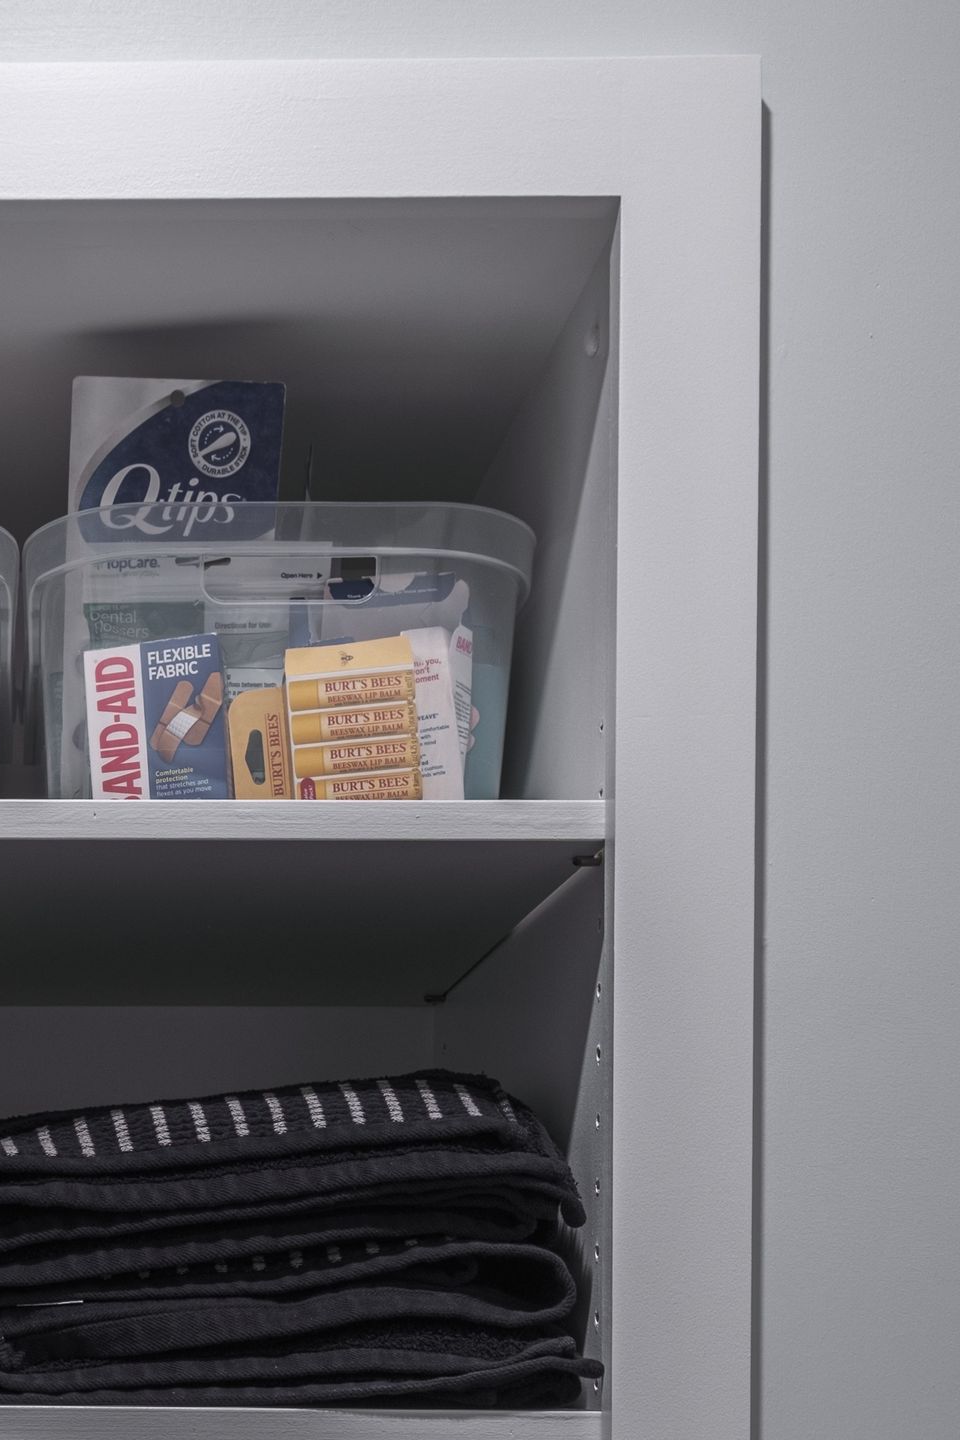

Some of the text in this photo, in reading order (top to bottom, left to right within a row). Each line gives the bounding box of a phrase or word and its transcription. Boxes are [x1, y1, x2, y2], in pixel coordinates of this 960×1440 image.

[192, 413, 216, 436] COTTON
[227, 414, 240, 425] THE
[238, 424, 247, 436] TIP
[190, 438, 198, 458] SOFT
[202, 446, 248, 475] DURABLE STICK
[90, 609, 136, 624] Dental
[214, 622, 246, 630] Directions
[147, 644, 212, 665] FLEXIBLE
[148, 661, 198, 680] FABRIC
[325, 676, 402, 692] BURT'S BEES
[415, 674, 439, 684] oment
[327, 694, 364, 704] BEESWAX
[379, 689, 401, 698] BALM
[328, 709, 404, 726] BURT'S BEES
[95, 656, 142, 800] AND-AID
[330, 726, 366, 736] BEESWAX
[382, 722, 404, 731] BALM
[268, 714, 285, 796] BURT'S BEES
[330, 742, 406, 760] BURT'S BEES
[332, 760, 368, 770] BEESWAX
[370, 758, 382, 766] LIP
[384, 756, 406, 764] BALM
[155, 767, 194, 777] Comfortable
[156, 774, 188, 784] protection
[170, 780, 196, 789] stretches
[197, 778, 209, 786] and
[332, 776, 410, 793] BURT'S BEES
[156, 789, 174, 798] flexes
[182, 788, 194, 796] you
[372, 792, 386, 800] LIP
[387, 790, 408, 798] BALM
